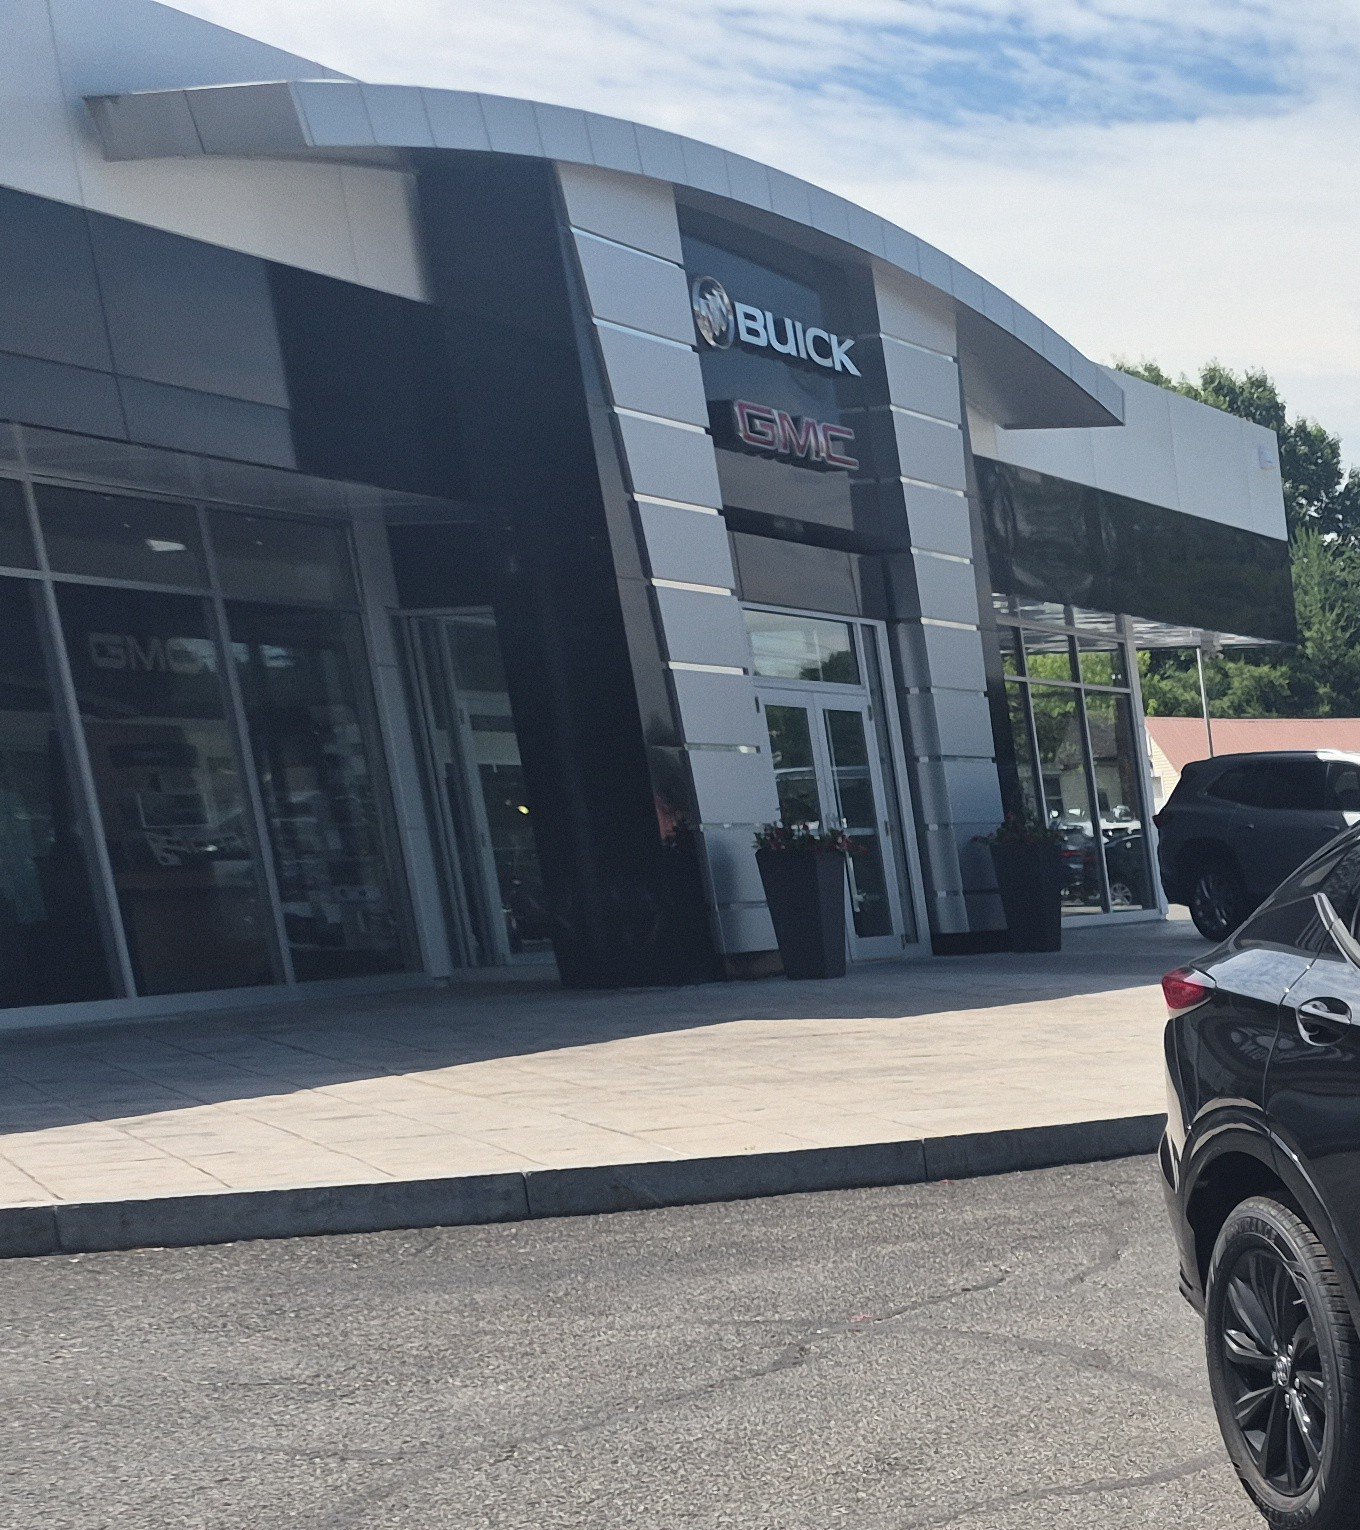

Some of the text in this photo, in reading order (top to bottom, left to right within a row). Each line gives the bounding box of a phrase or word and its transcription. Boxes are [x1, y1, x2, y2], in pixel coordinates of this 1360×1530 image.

[733, 301, 861, 377] BUICK
[734, 400, 859, 470] GMC
[89, 631, 210, 673] GMC
